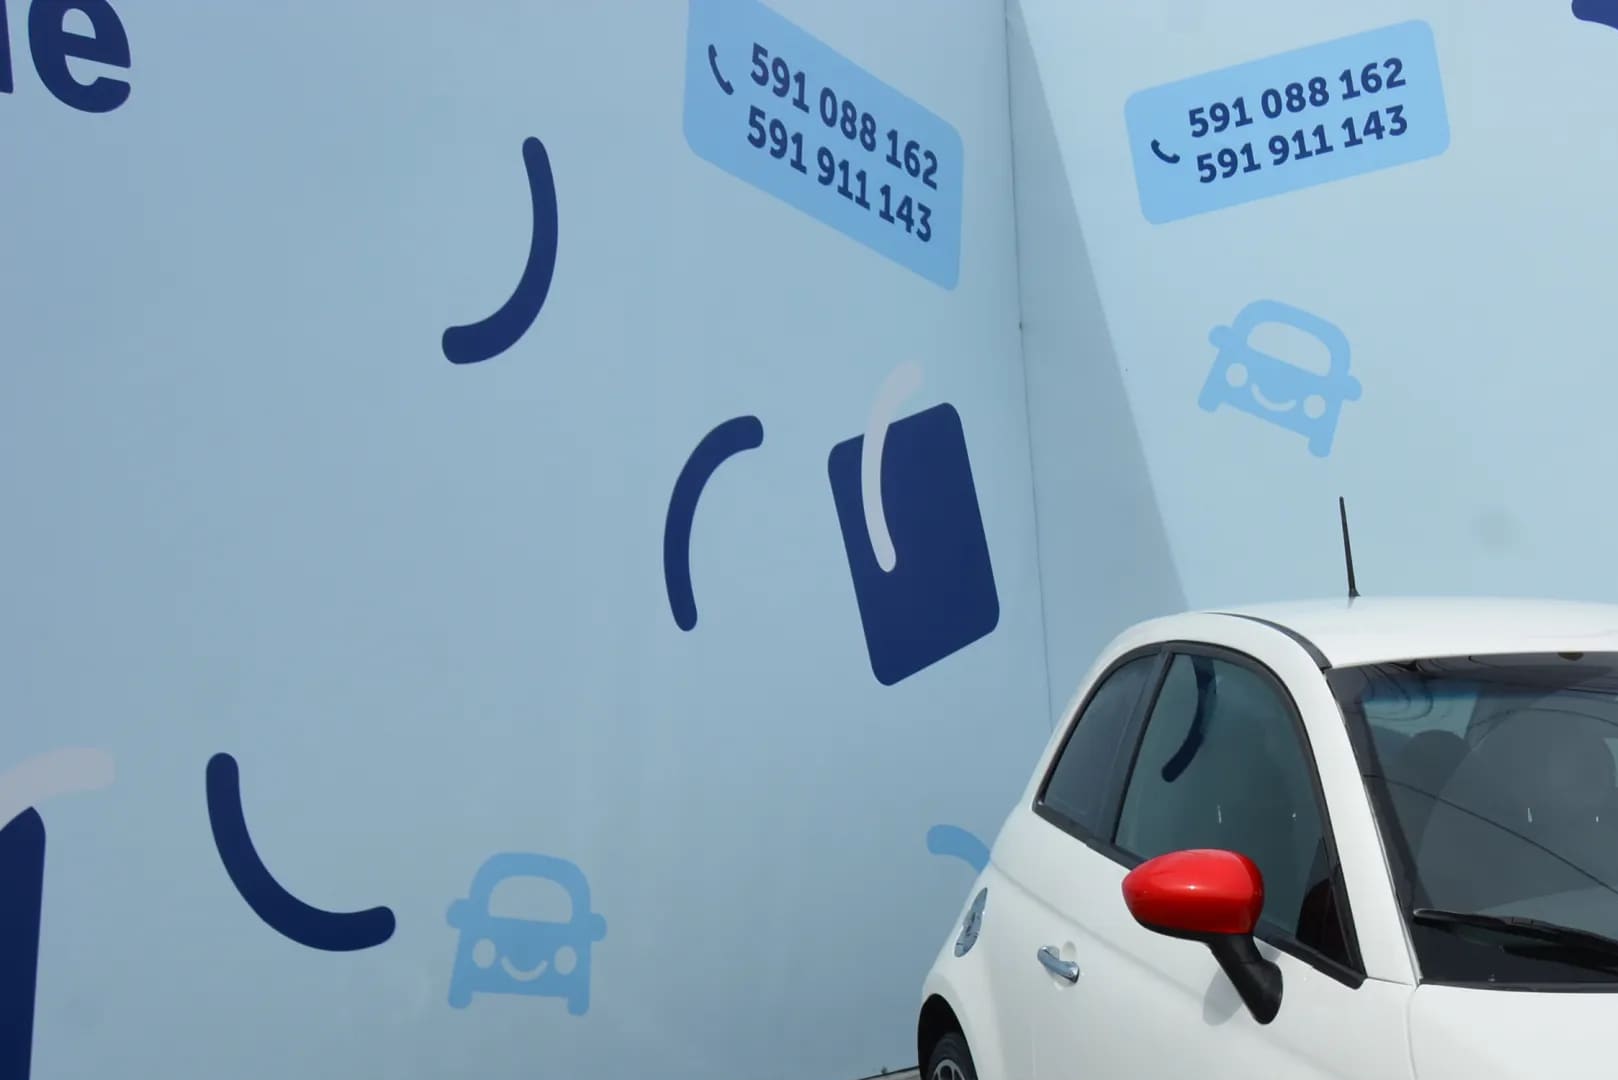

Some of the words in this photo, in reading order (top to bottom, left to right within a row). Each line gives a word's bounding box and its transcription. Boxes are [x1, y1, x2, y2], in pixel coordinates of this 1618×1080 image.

[750, 42, 810, 114] 591
[819, 86, 877, 153] 088
[885, 128, 938, 191] 162
[1188, 96, 1254, 138] 591
[1261, 76, 1330, 119] 088
[1339, 57, 1406, 101] 162
[1196, 142, 1262, 184] 591
[1268, 124, 1334, 166] 911
[1341, 104, 1408, 148] 143
[747, 104, 808, 175] 591
[816, 146, 871, 211] 911
[878, 183, 932, 243] 143
